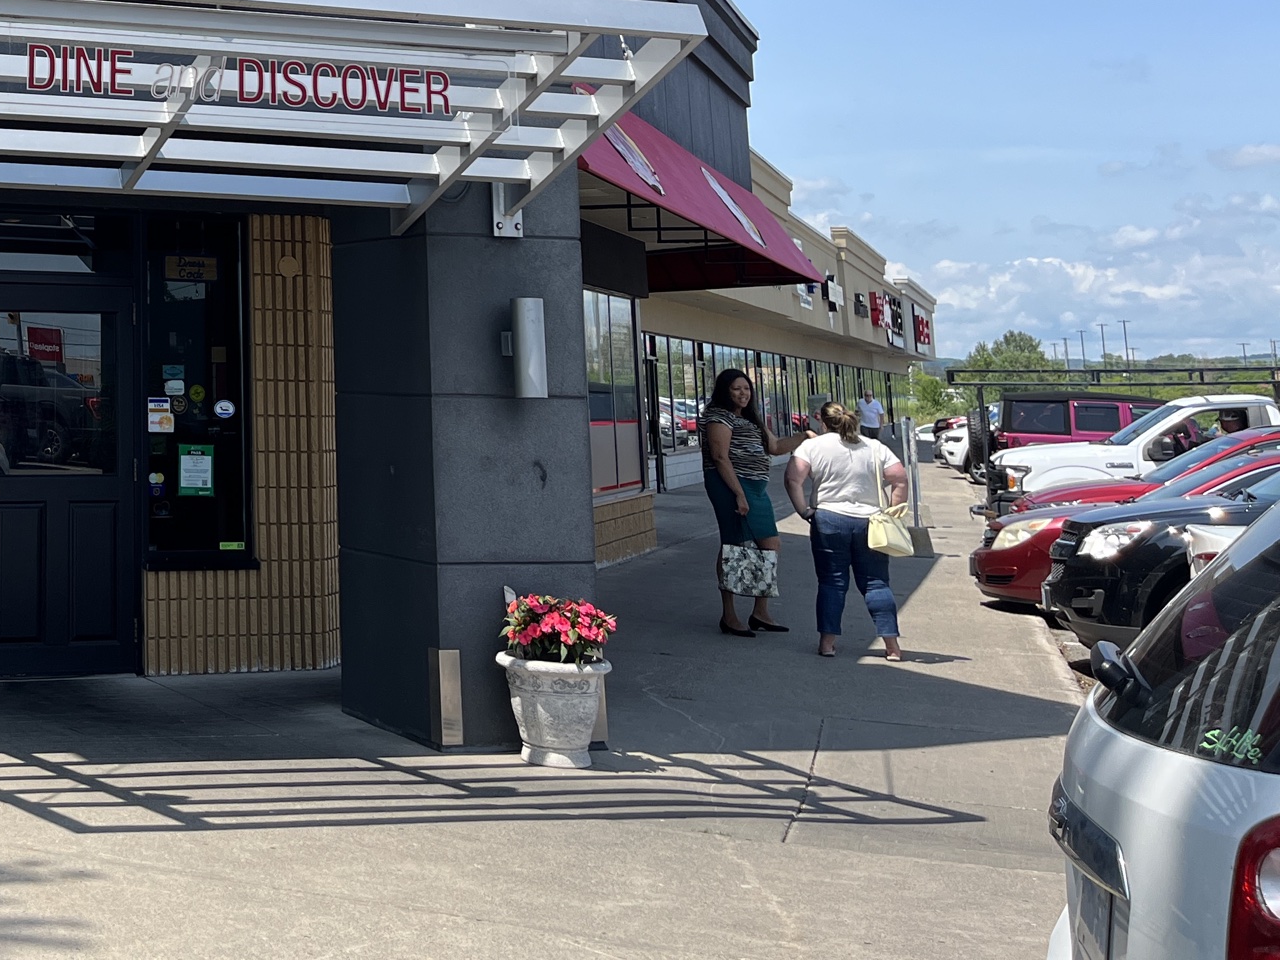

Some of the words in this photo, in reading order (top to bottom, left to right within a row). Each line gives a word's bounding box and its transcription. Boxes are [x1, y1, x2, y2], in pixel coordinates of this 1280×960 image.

[26, 43, 135, 96] DINE
[151, 56, 228, 102] and
[236, 56, 453, 116] DISCOVER
[178, 268, 205, 279] Code
